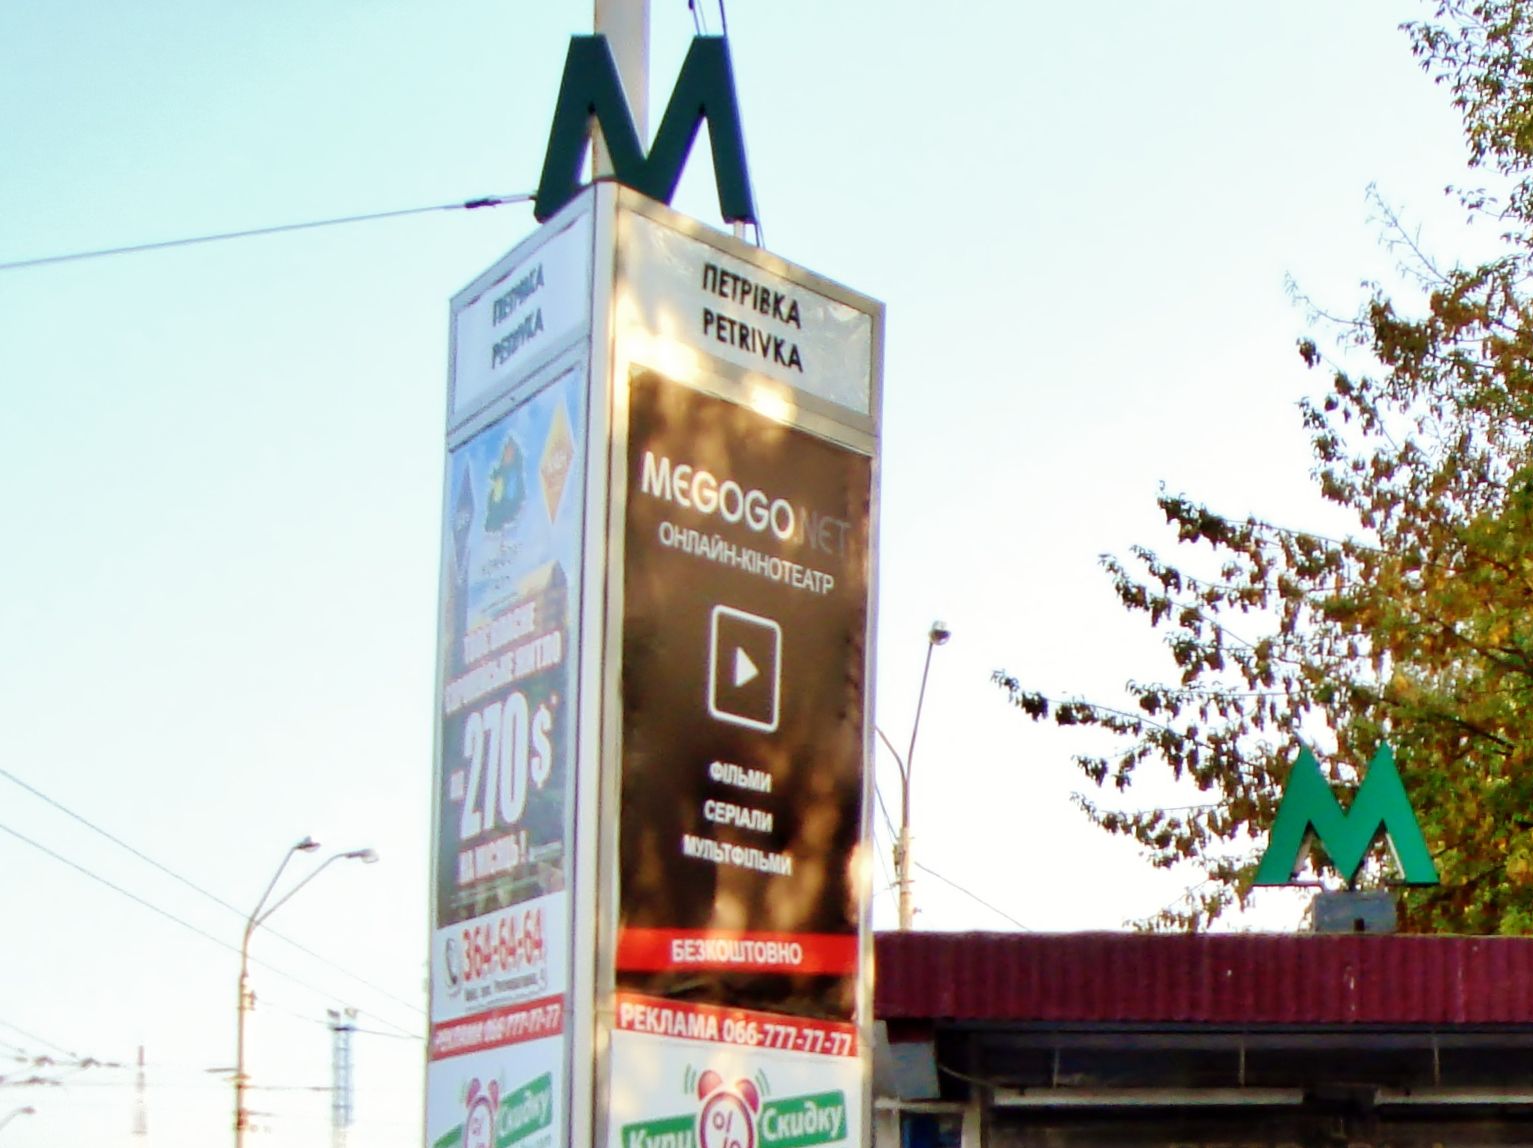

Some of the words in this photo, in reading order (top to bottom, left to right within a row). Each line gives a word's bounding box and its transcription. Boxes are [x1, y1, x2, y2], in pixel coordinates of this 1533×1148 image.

[701, 262, 801, 330] ПЕТРІВКА
[702, 308, 804, 373] PETRIVKA
[658, 521, 835, 595] ОНЛАЙН-КІНОТЕАТР
[708, 760, 773, 793] ФІЛЬМИ
[704, 799, 773, 833] СЕРІАЛИ
[682, 834, 793, 876] МУЛЬТФІЛЬМИ
[671, 938, 804, 965] БЕЗКОШТОВНО
[620, 1002, 718, 1040] РЕКЛАМА
[722, 1018, 852, 1056] 066-777-77-77
[761, 1101, 843, 1142] Скидку
